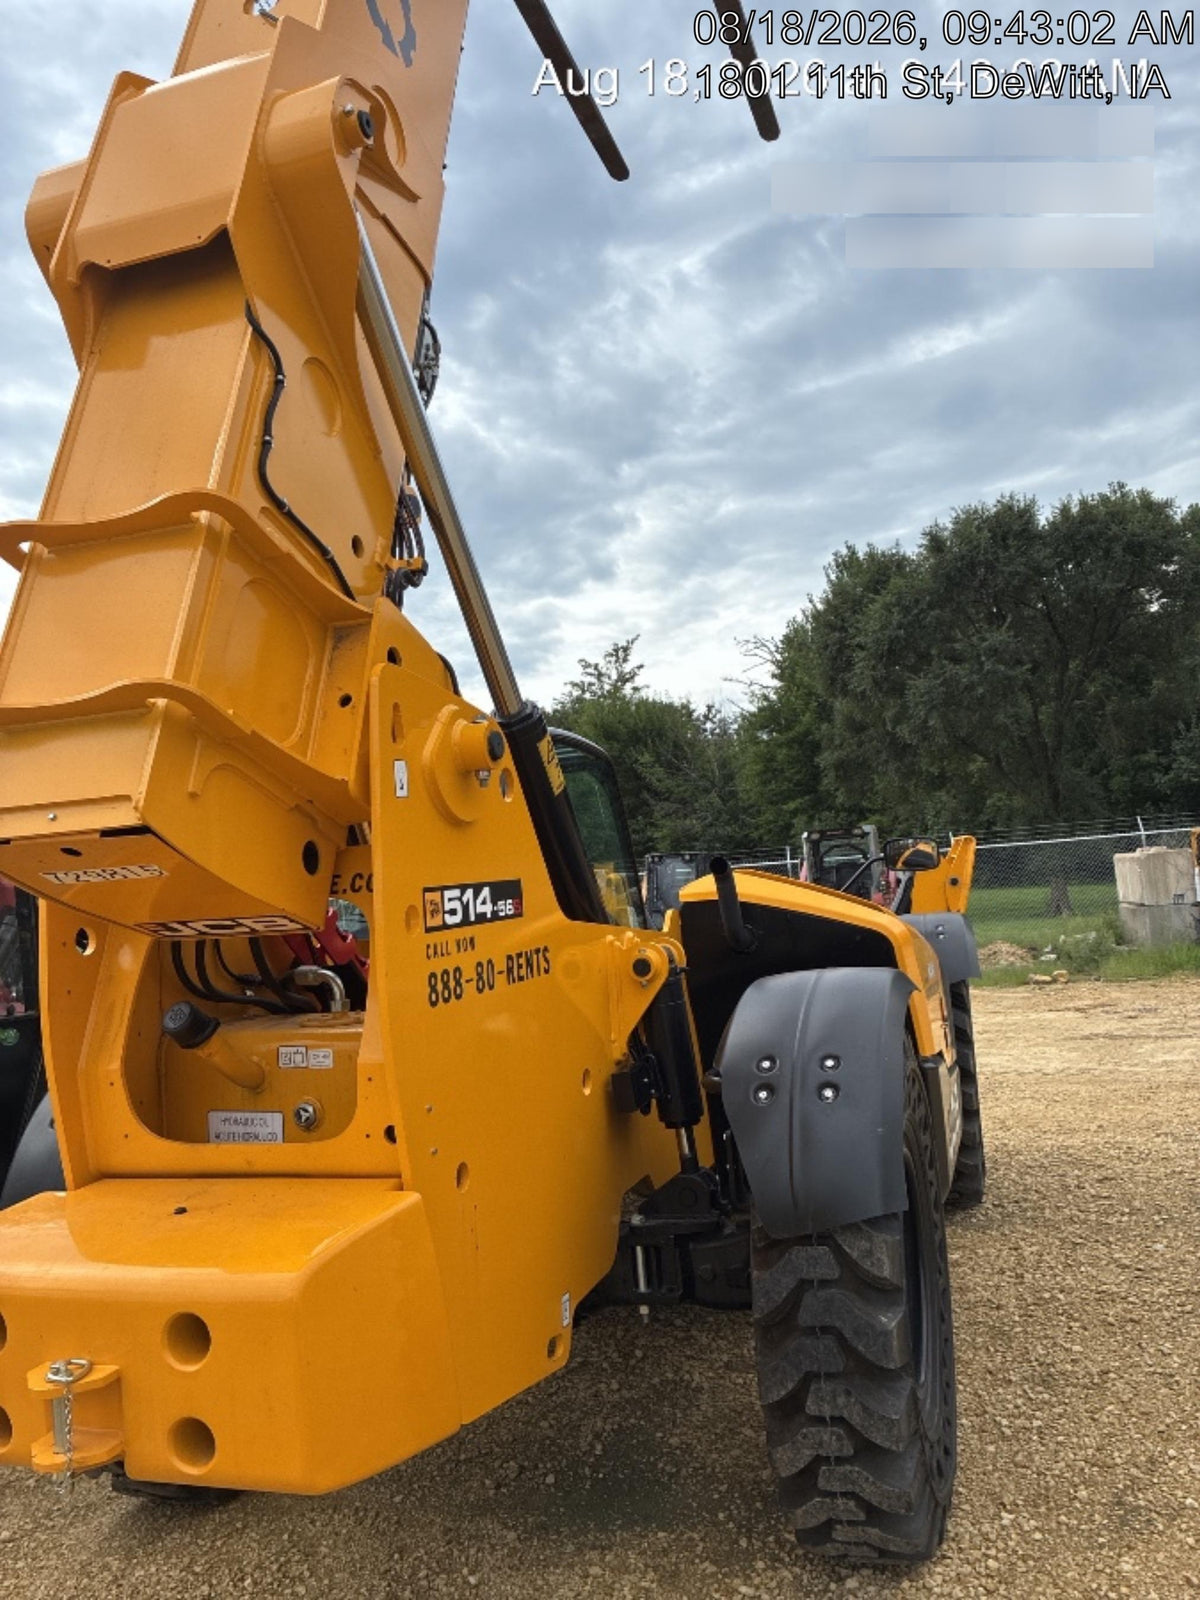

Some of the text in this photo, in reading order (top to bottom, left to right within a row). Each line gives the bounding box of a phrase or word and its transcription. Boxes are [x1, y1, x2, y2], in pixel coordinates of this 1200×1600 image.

[157, 916, 304, 937] JCB
[426, 936, 476, 960] CALL NOW
[428, 945, 551, 1009] 888-80-RENTS
